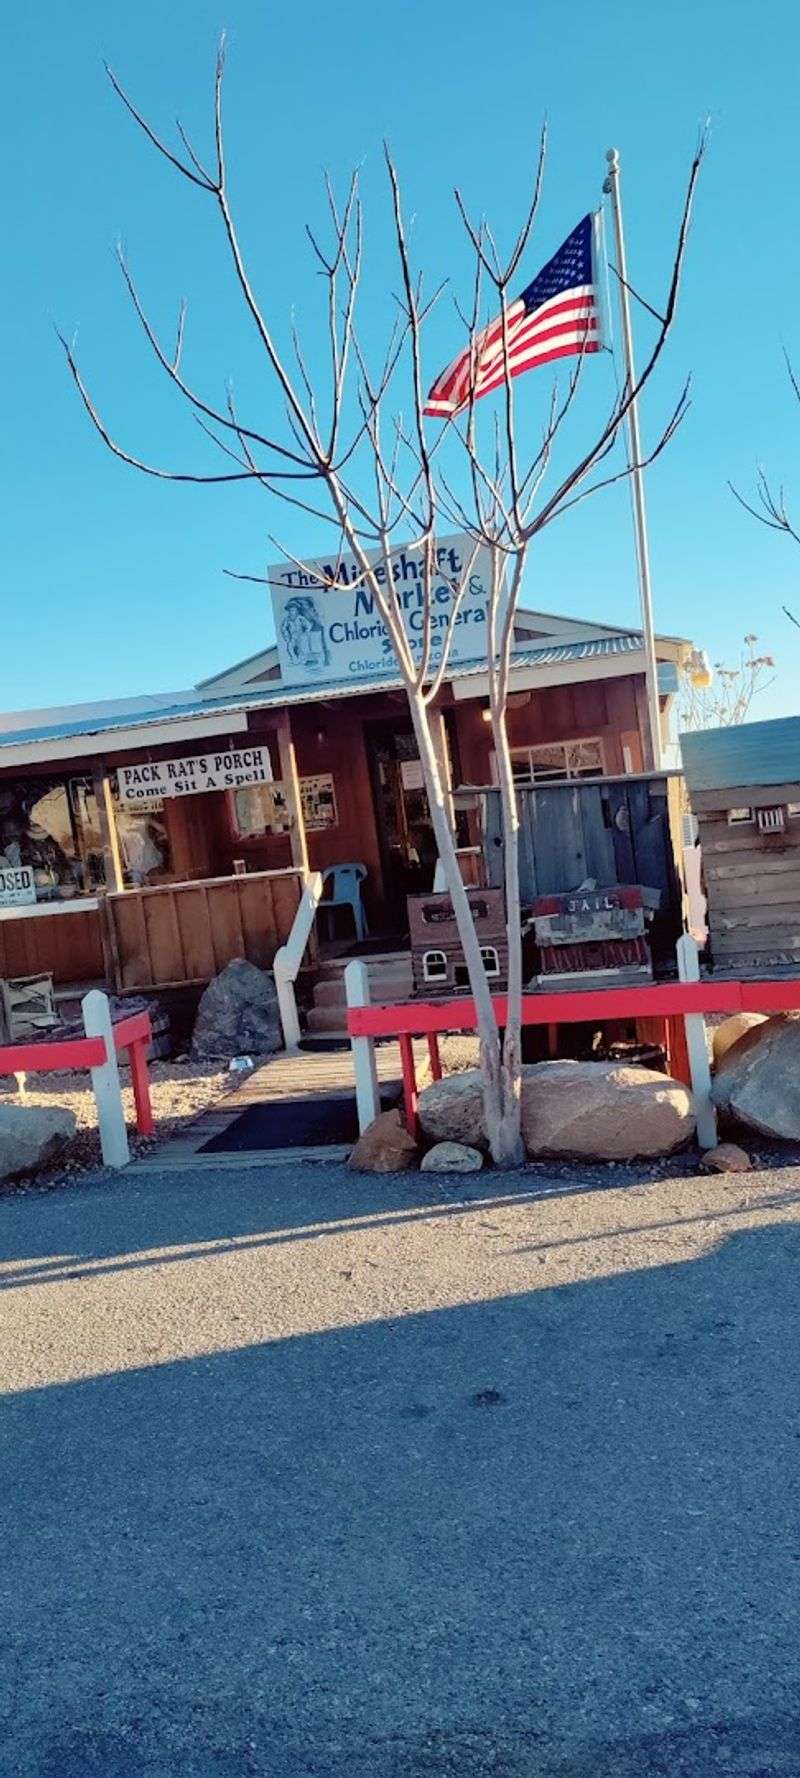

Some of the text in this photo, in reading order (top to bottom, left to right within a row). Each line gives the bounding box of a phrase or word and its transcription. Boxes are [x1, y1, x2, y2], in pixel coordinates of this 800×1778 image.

[281, 569, 320, 586] The
[468, 574, 487, 596] &
[329, 619, 392, 643] Chlori
[124, 751, 263, 785] PACK RAT'S PORCH
[126, 768, 266, 799] Come Sit A Spell
[567, 898, 614, 912] JAIL
